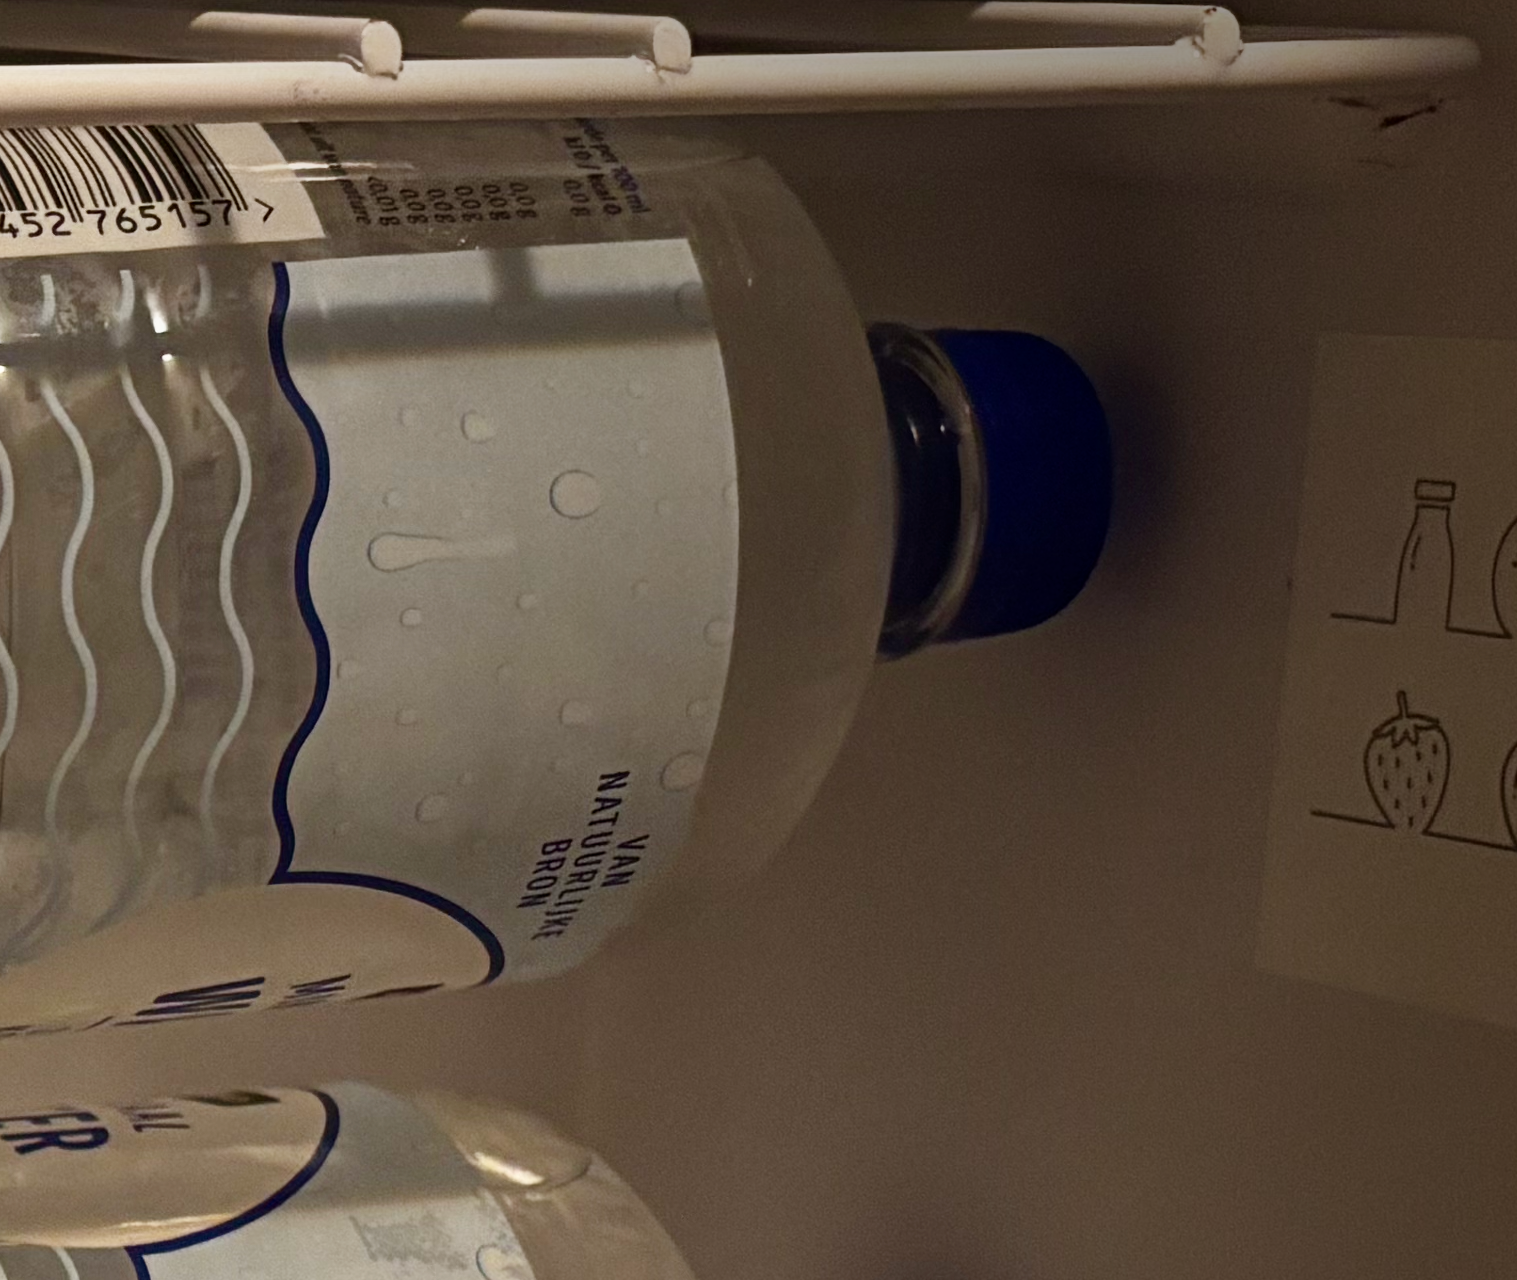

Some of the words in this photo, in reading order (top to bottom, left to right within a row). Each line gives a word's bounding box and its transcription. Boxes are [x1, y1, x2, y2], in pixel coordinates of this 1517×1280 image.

[85, 200, 236, 235] 765157
[516, 838, 573, 910] BRON
[530, 770, 632, 941] NATUURLIJKE
[600, 834, 651, 888] VAN
